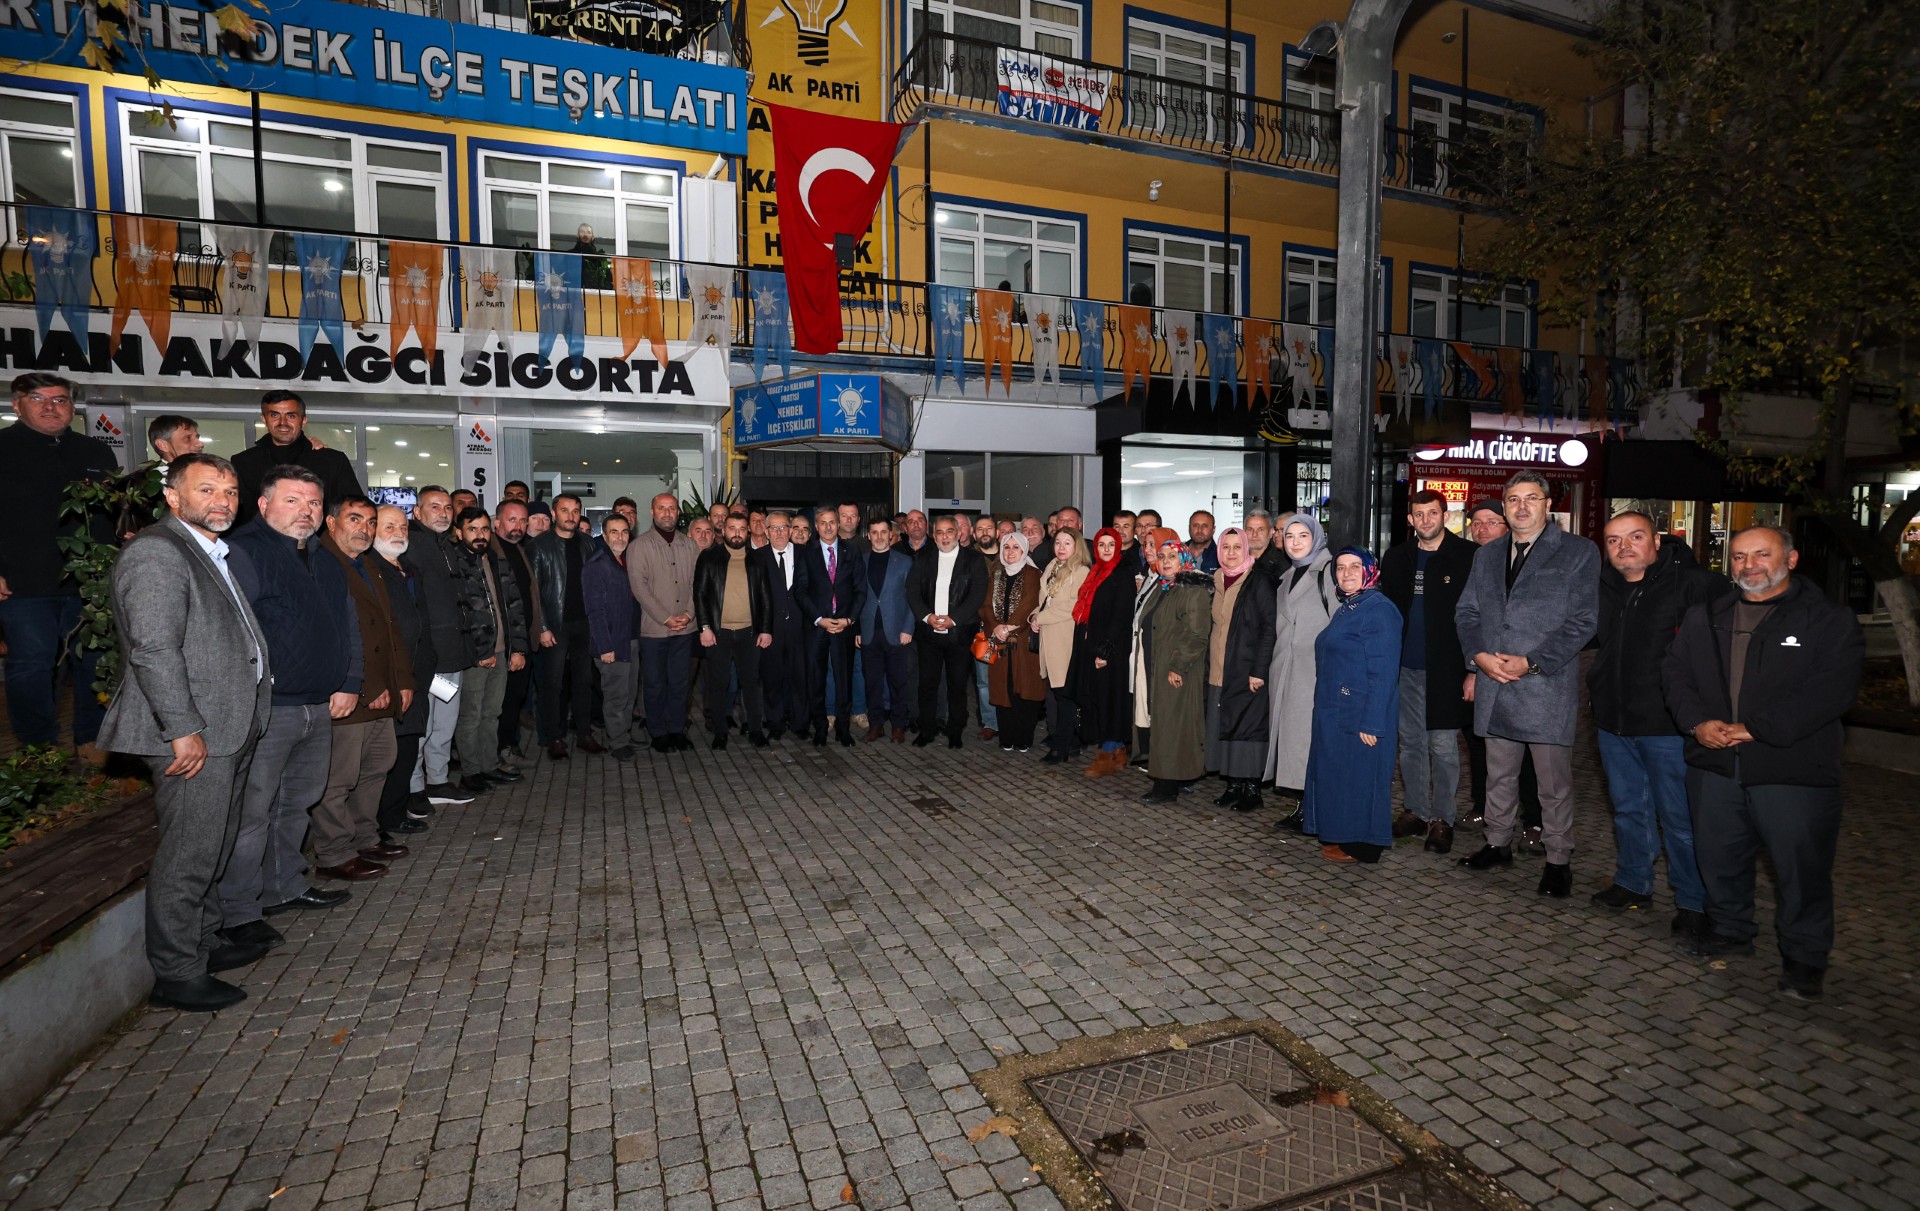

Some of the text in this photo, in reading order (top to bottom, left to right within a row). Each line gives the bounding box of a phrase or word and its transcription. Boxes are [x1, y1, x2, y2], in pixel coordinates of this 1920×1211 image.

[574, 10, 642, 37] RENT
[372, 27, 485, 101] İLÇE
[500, 57, 737, 132] TEŞKİLATI
[768, 72, 860, 103] AK PARTİ
[305, 290, 316, 299] AK
[475, 300, 484, 308] AK
[542, 302, 551, 310] AK
[624, 308, 634, 316] AK
[158, 332, 447, 386] AKDAĞCI
[459, 341, 695, 396] SİGORTA
[777, 404, 804, 419] HENDEK
[767, 418, 815, 436] İLÇE TEŞKİLATI
[1488, 434, 1558, 465] ÇİĞKÖFTE
[1484, 469, 1507, 477] DOLMA
[1181, 1100, 1225, 1120] TÜRK
[1177, 1113, 1260, 1143] TELEKOM
